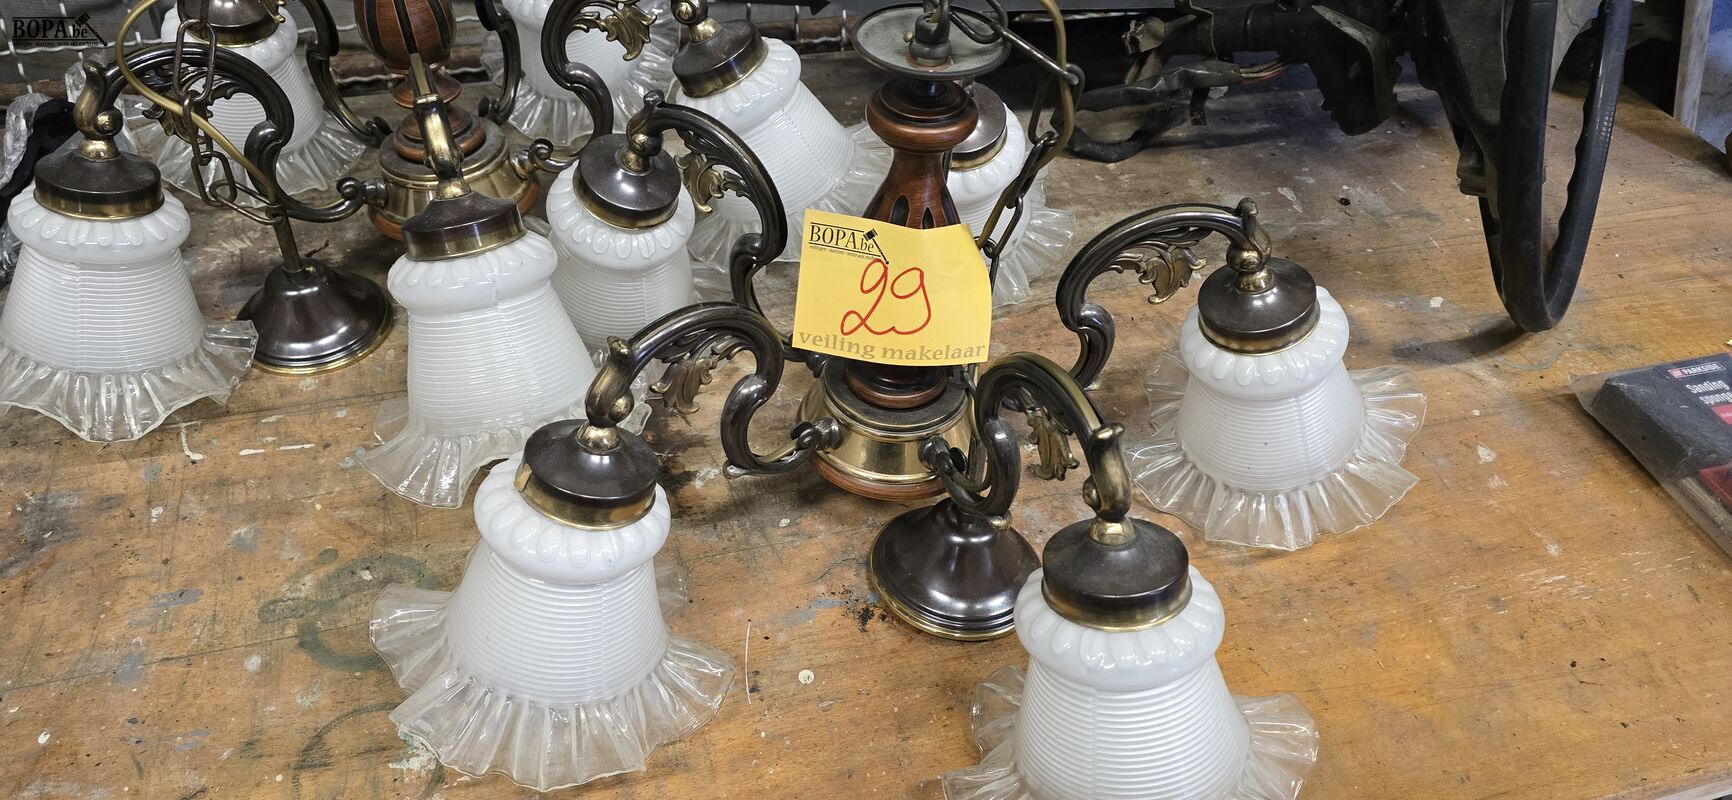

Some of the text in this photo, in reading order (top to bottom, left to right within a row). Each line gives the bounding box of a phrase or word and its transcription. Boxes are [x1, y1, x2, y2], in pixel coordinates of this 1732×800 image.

[810, 224, 874, 252] BOPA.be
[798, 331, 985, 361] veiling makelaar
[1681, 363, 1722, 375] PARKSIDE
[1685, 380, 1730, 393] Sanding
